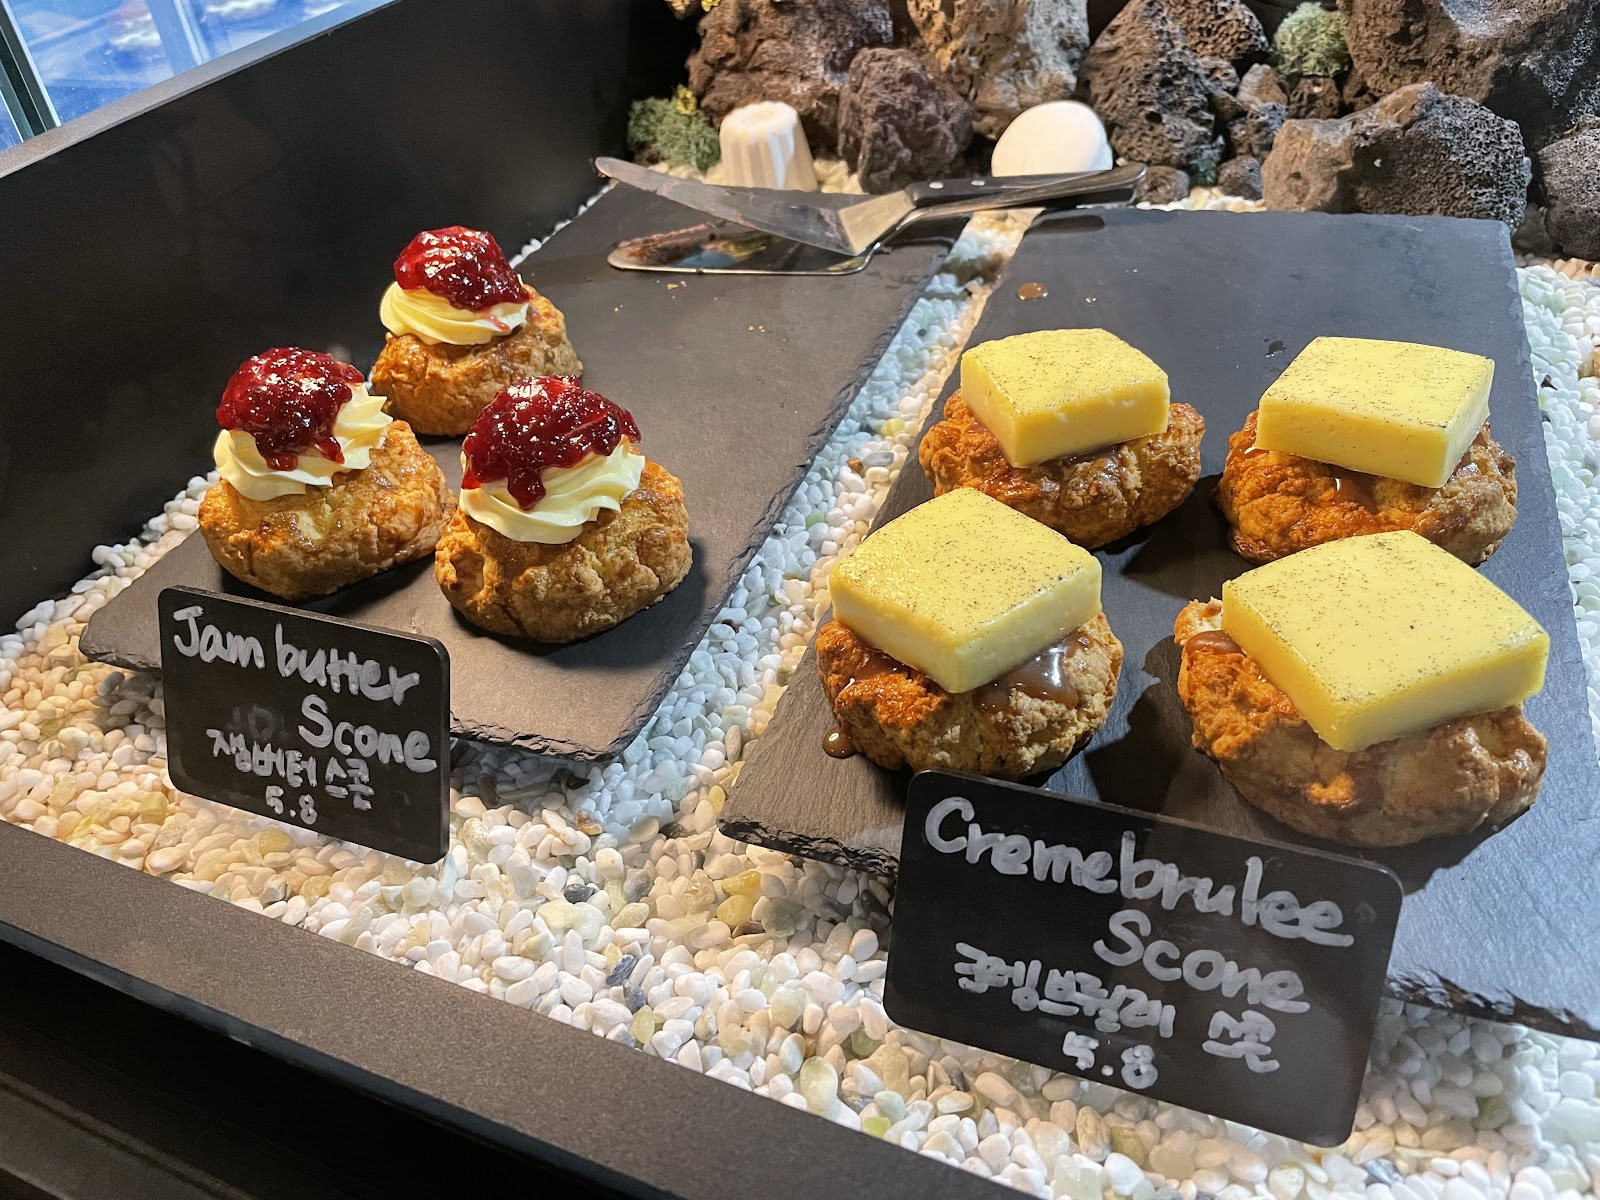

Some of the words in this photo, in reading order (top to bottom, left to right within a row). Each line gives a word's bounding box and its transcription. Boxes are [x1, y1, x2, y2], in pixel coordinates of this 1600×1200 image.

[173, 605, 266, 669] Jam
[275, 622, 420, 706] butter
[298, 694, 438, 773] Scone
[265, 785, 318, 825] 5.8
[324, 757, 375, 811] 스콘
[1093, 909, 1311, 1014] Scone
[1062, 1031, 1158, 1089] 5.8
